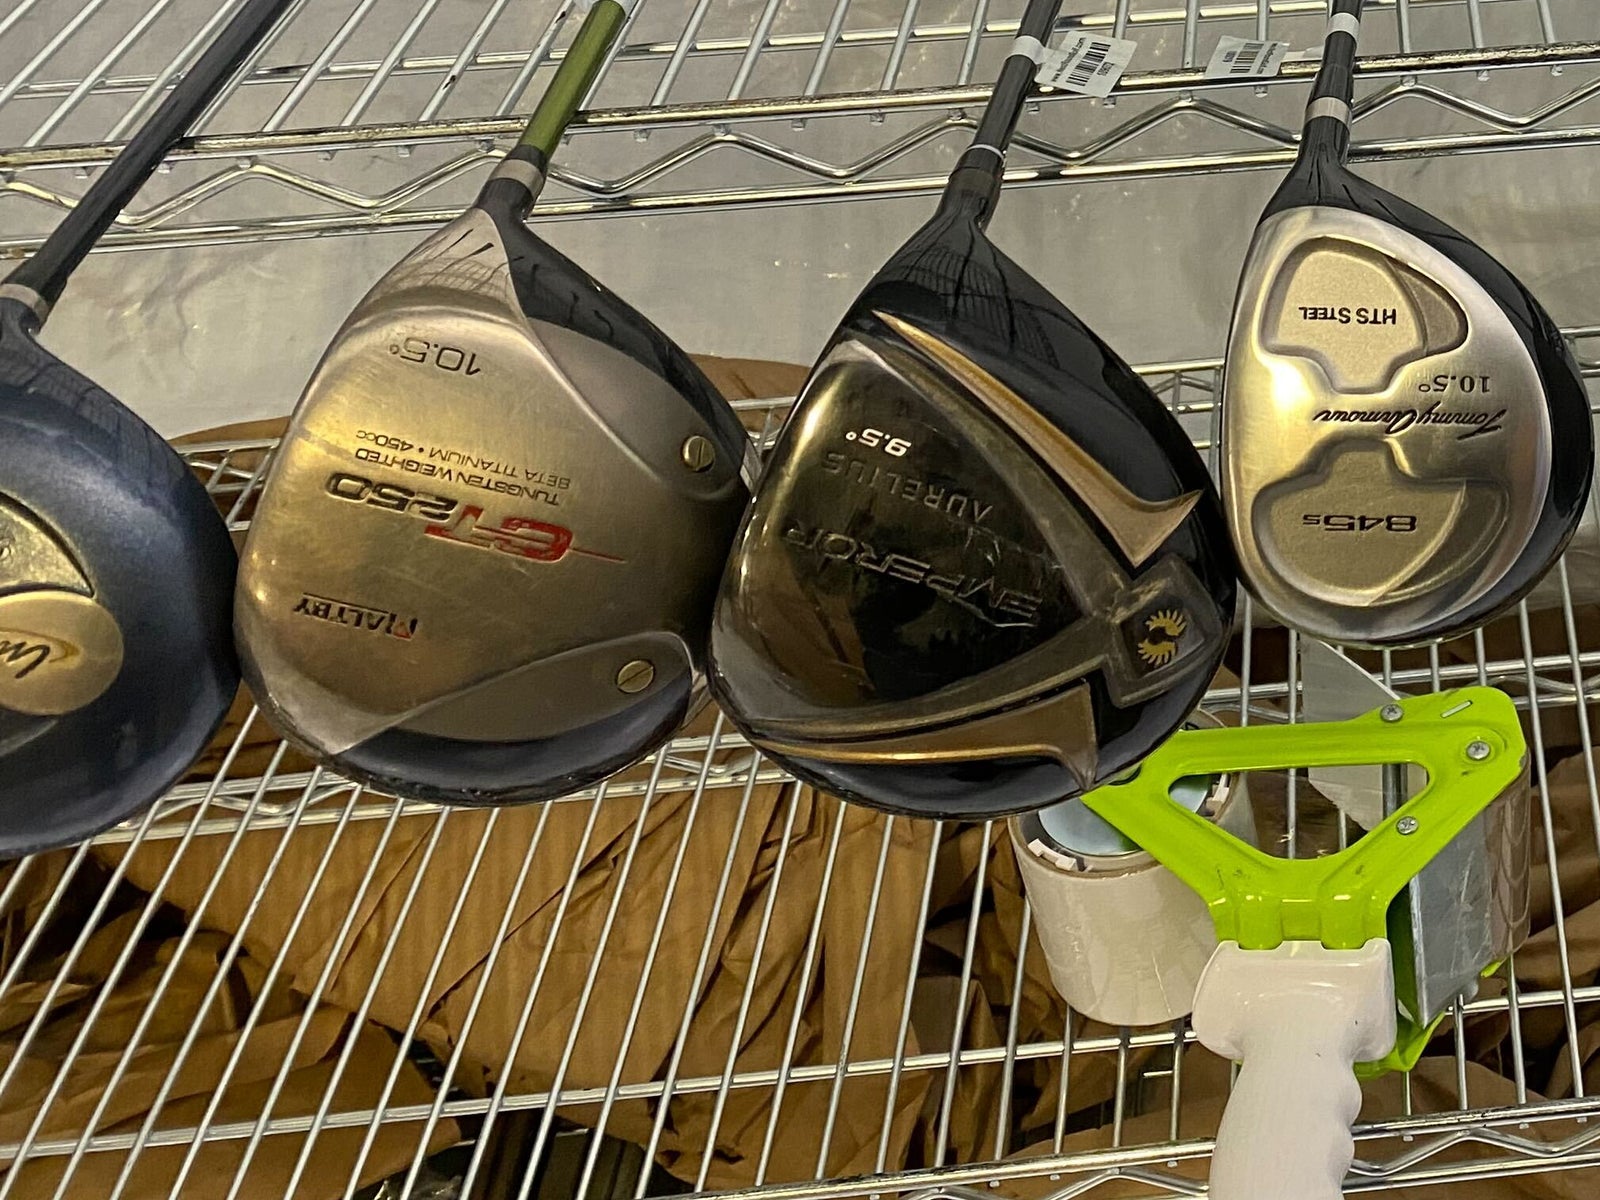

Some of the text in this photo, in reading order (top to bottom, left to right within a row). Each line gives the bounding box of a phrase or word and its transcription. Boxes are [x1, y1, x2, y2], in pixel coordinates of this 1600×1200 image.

[1355, 307, 1397, 326] HTS
[388, 335, 482, 377] 10.5°
[1418, 374, 1491, 394] 10.5°
[1415, 400, 1507, 441] Tommy
[355, 447, 560, 507] TUNGSTEN WEIGHTED
[428, 446, 518, 480] TITANIUM
[525, 468, 572, 490] BETA
[822, 450, 993, 524] AURELIUS
[785, 527, 1043, 618] EMPEROR
[293, 595, 419, 641] MALTBY
